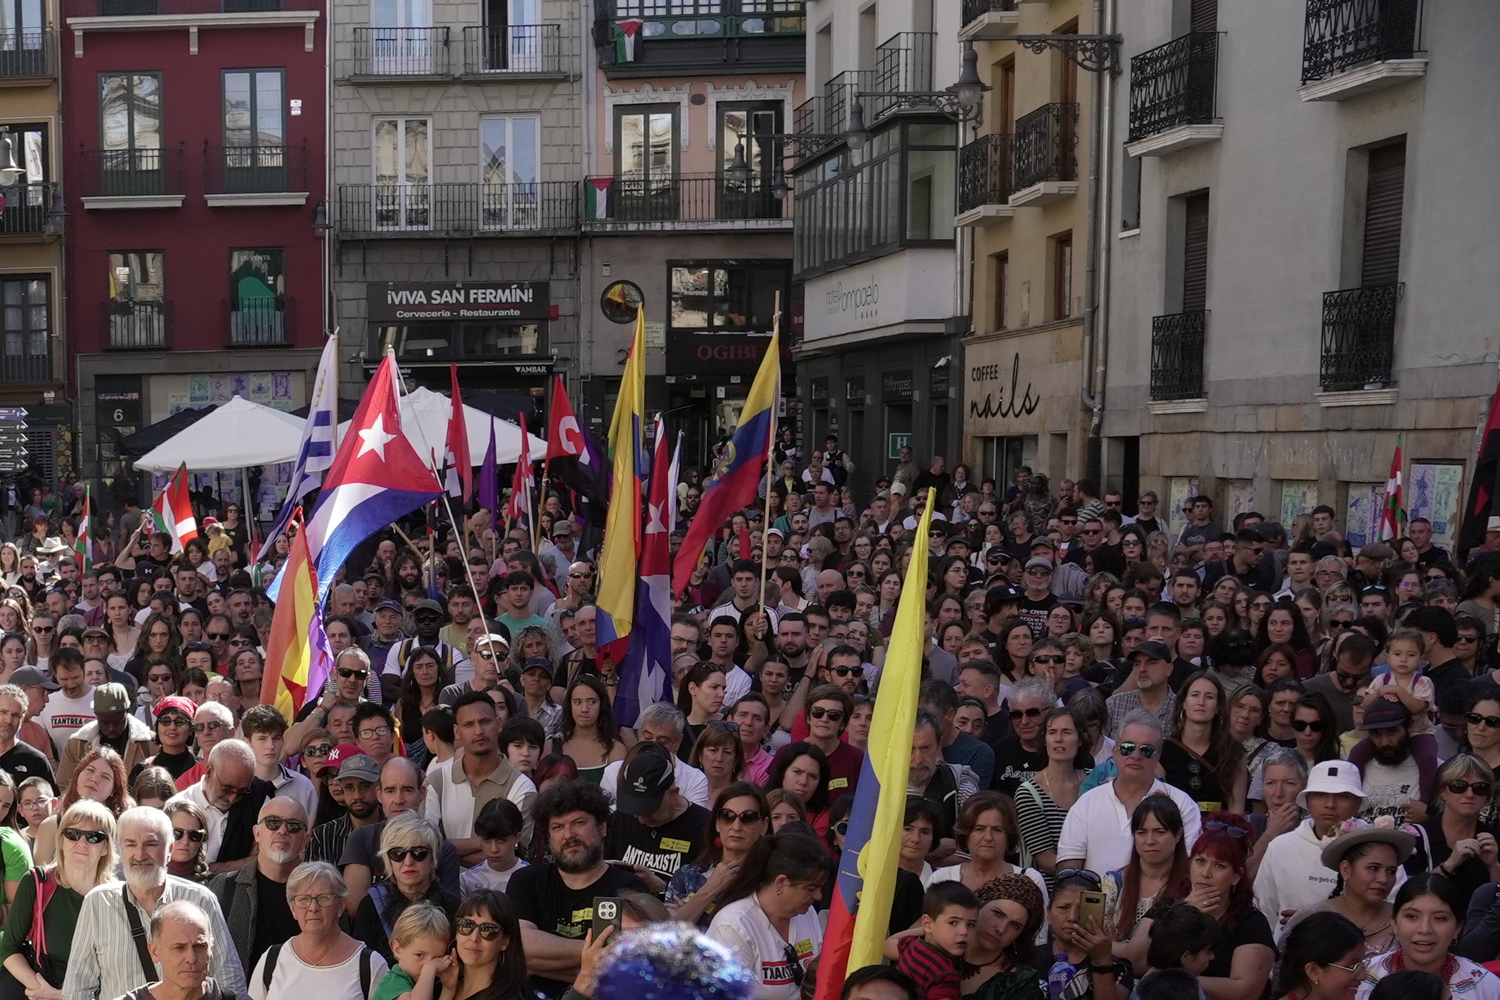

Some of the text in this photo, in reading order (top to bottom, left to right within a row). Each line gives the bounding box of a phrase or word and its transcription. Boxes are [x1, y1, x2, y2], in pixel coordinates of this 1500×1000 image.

[431, 289, 464, 304] SAN
[469, 285, 533, 304] FERMÍN!
[396, 309, 451, 319] Cervecería
[460, 308, 520, 317] Restaurante
[972, 364, 999, 382] COFFEE
[970, 352, 1040, 419] nails
[113, 409, 124, 421] 6
[622, 844, 682, 874] ANTIFAXISTA
